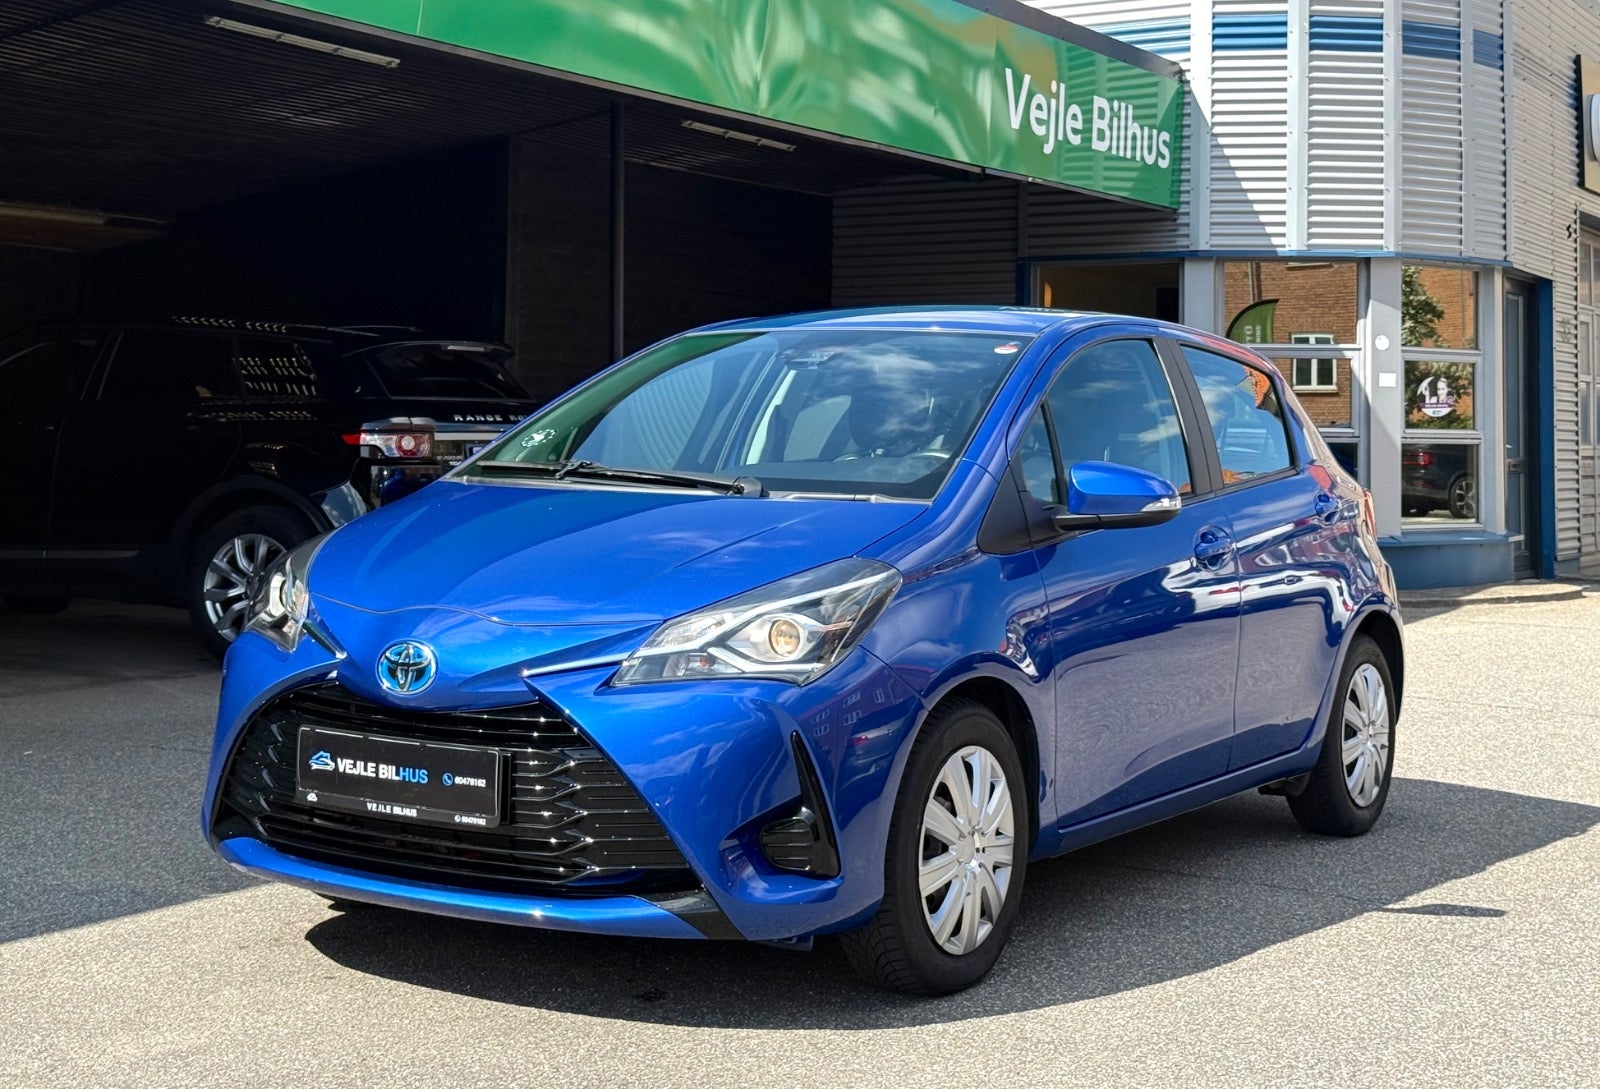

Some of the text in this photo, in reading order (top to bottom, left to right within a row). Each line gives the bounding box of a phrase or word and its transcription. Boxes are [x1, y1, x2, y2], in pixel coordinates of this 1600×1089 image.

[1005, 67, 1170, 169] Vejle Bilhus
[337, 758, 429, 784] VEJLE BILHUS
[366, 802, 417, 817] VEJLE BILHUS
